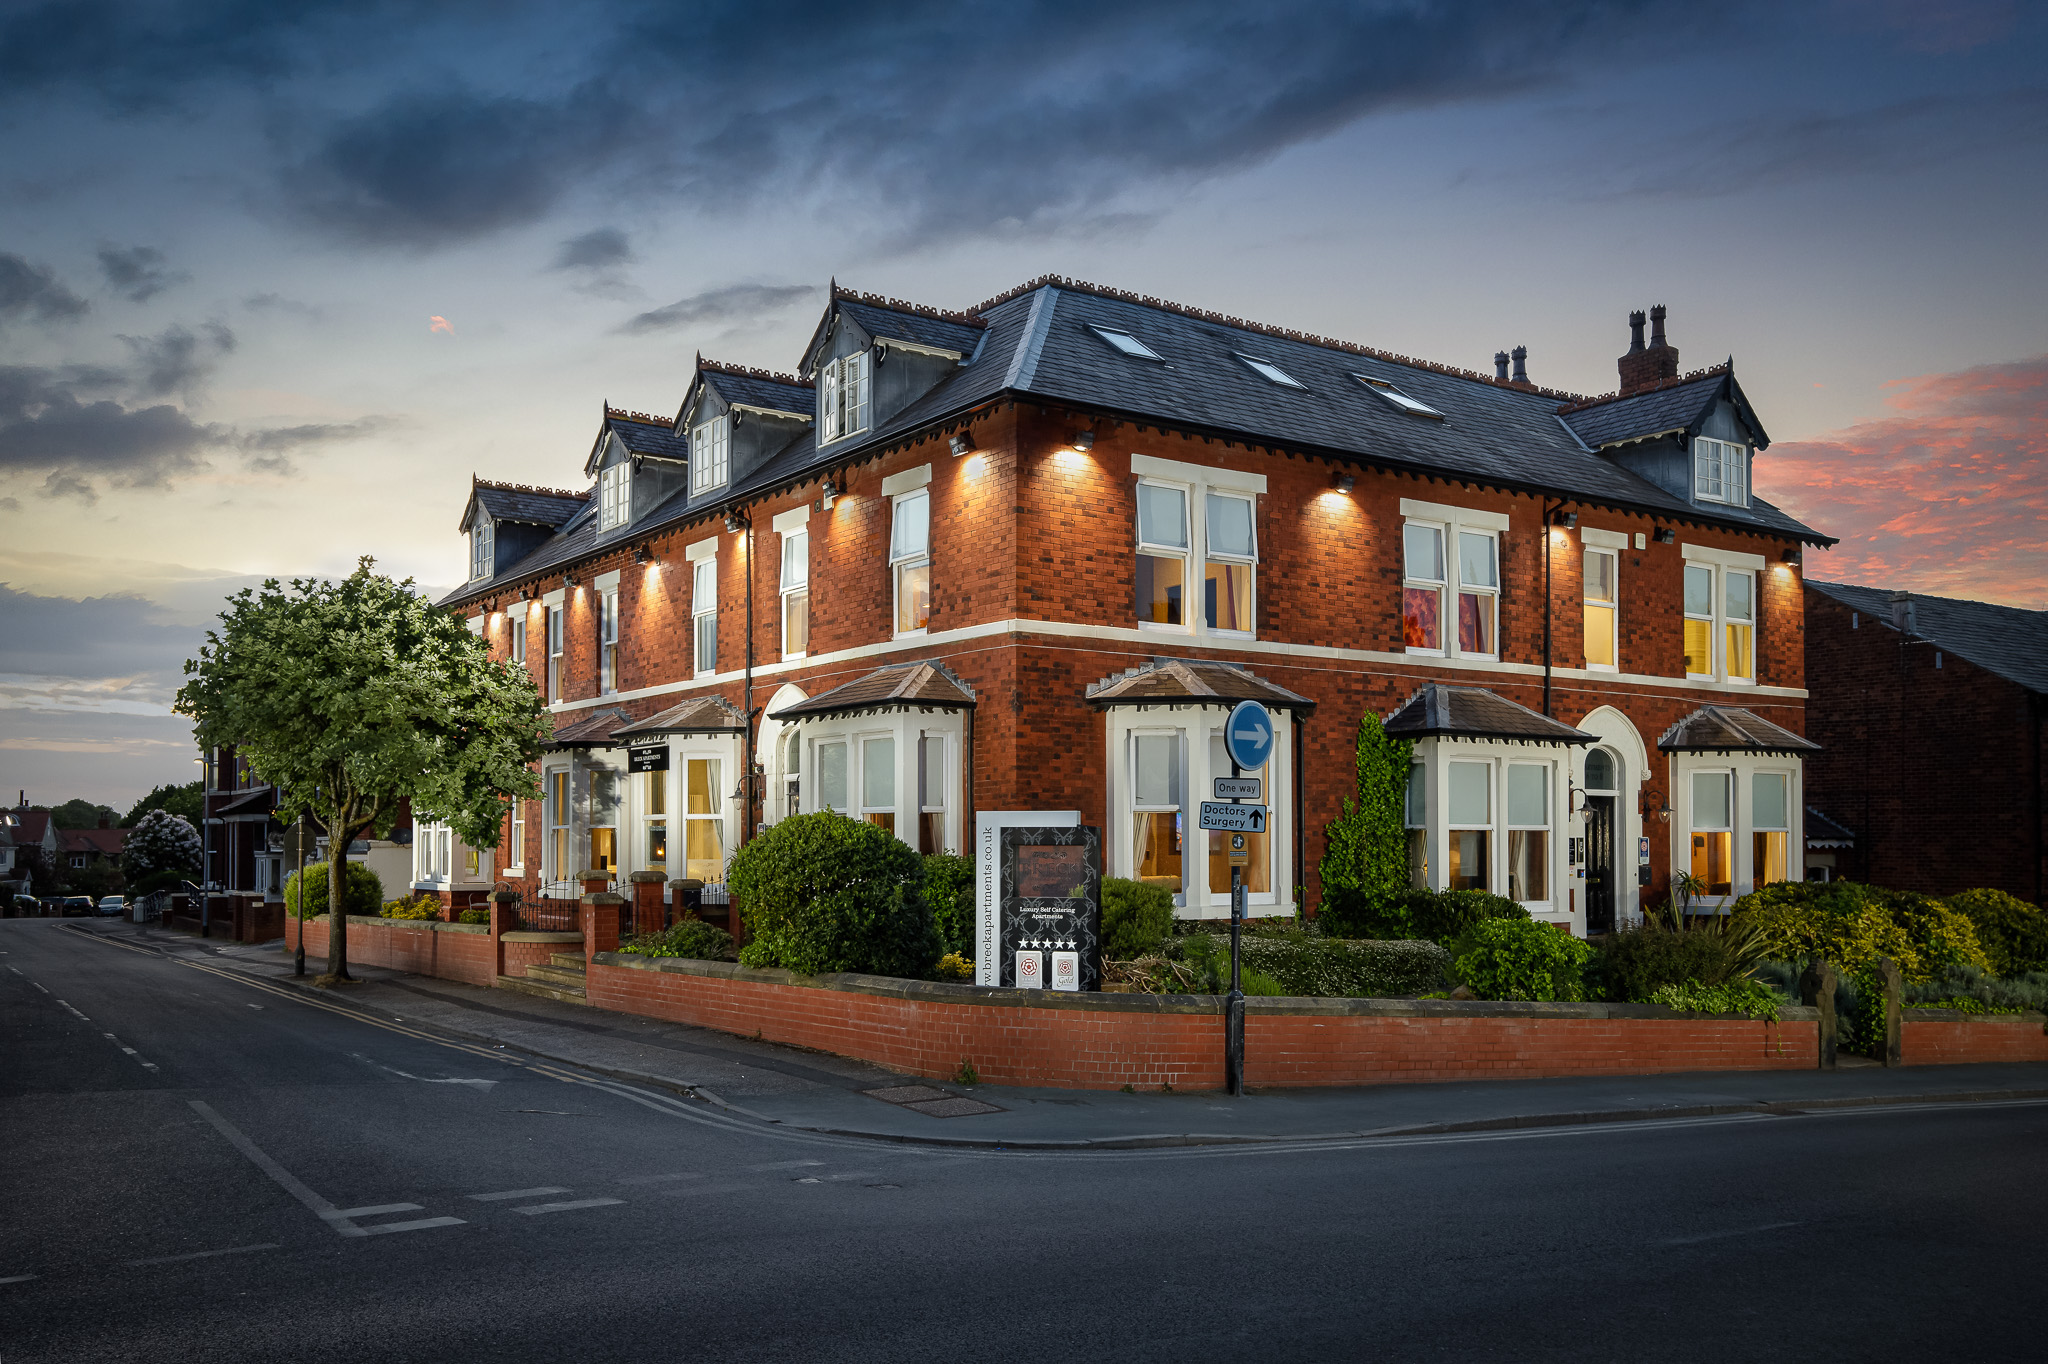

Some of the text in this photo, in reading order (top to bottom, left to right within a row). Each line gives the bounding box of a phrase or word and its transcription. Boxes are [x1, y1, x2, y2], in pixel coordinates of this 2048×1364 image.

[1219, 783, 1256, 794] One way
[1204, 804, 1246, 816] Doctors
[1203, 816, 1246, 828] Surgery
[1056, 977, 1074, 987] Gold
